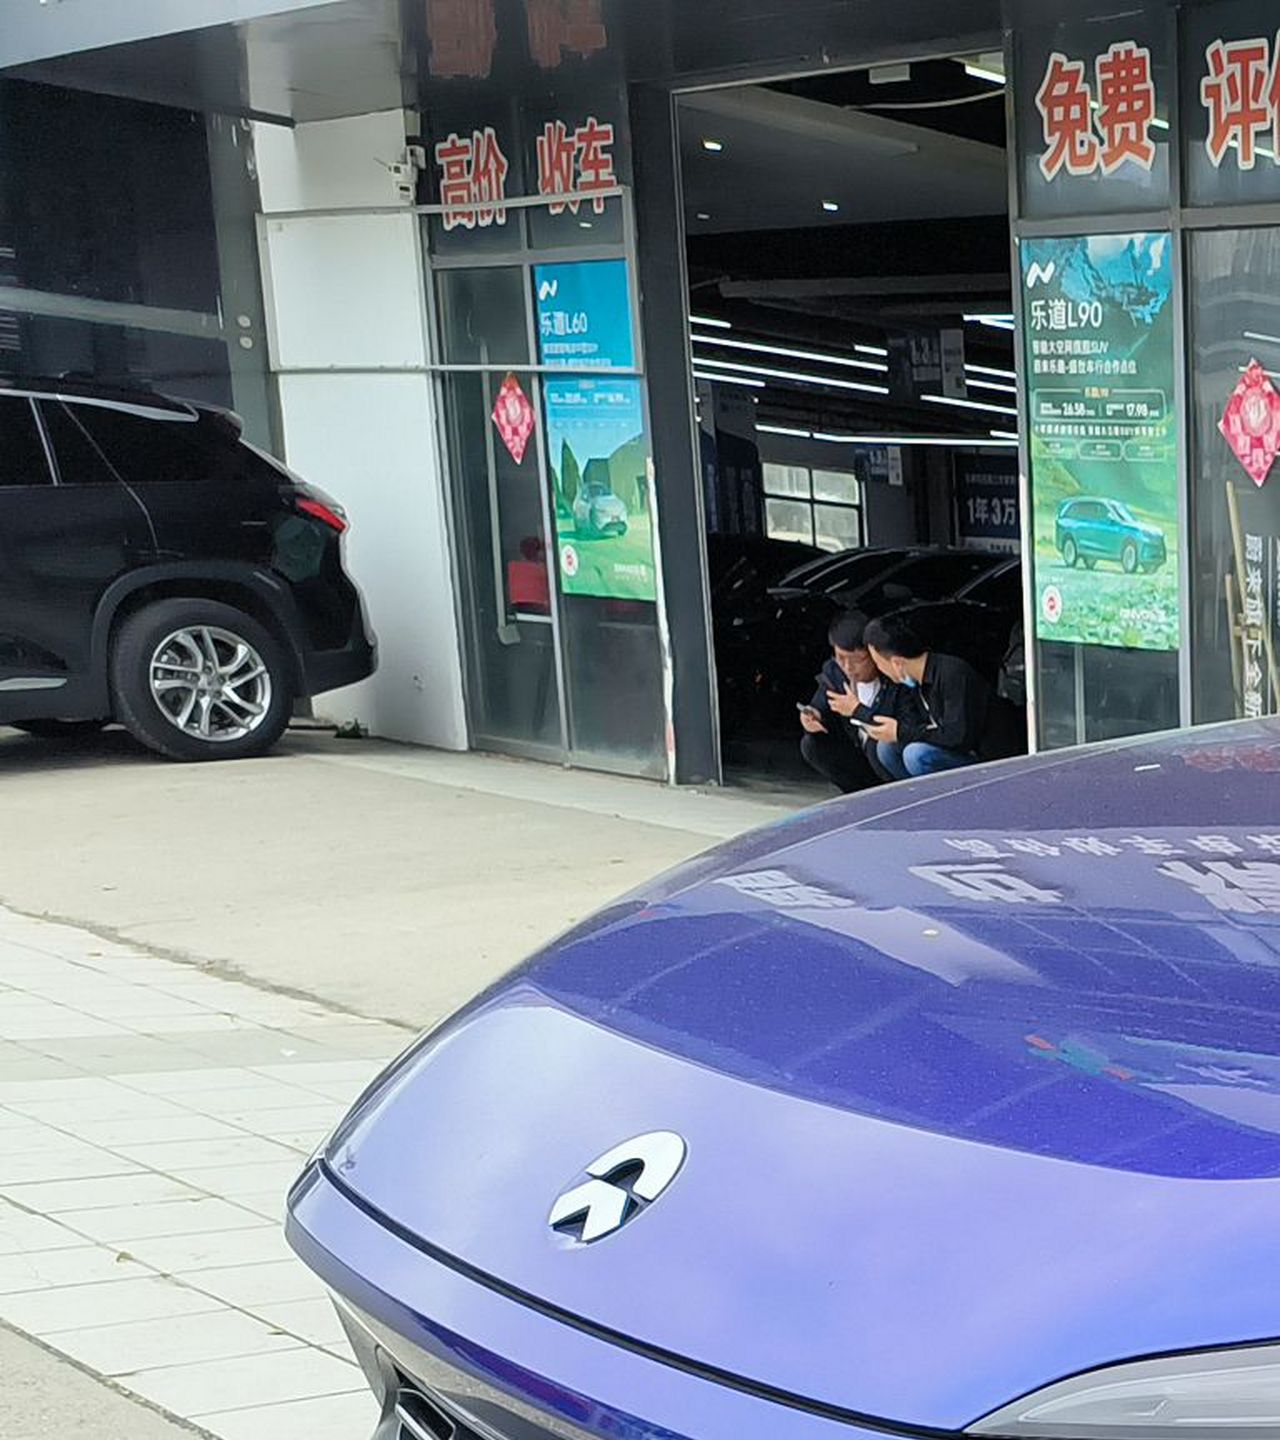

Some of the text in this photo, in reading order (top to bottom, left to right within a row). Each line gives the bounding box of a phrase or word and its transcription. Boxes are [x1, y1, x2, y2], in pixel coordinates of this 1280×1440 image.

[1036, 40, 1156, 181] 免费
[435, 117, 616, 231] 高价 收车
[1029, 298, 1103, 331] 乐道L90
